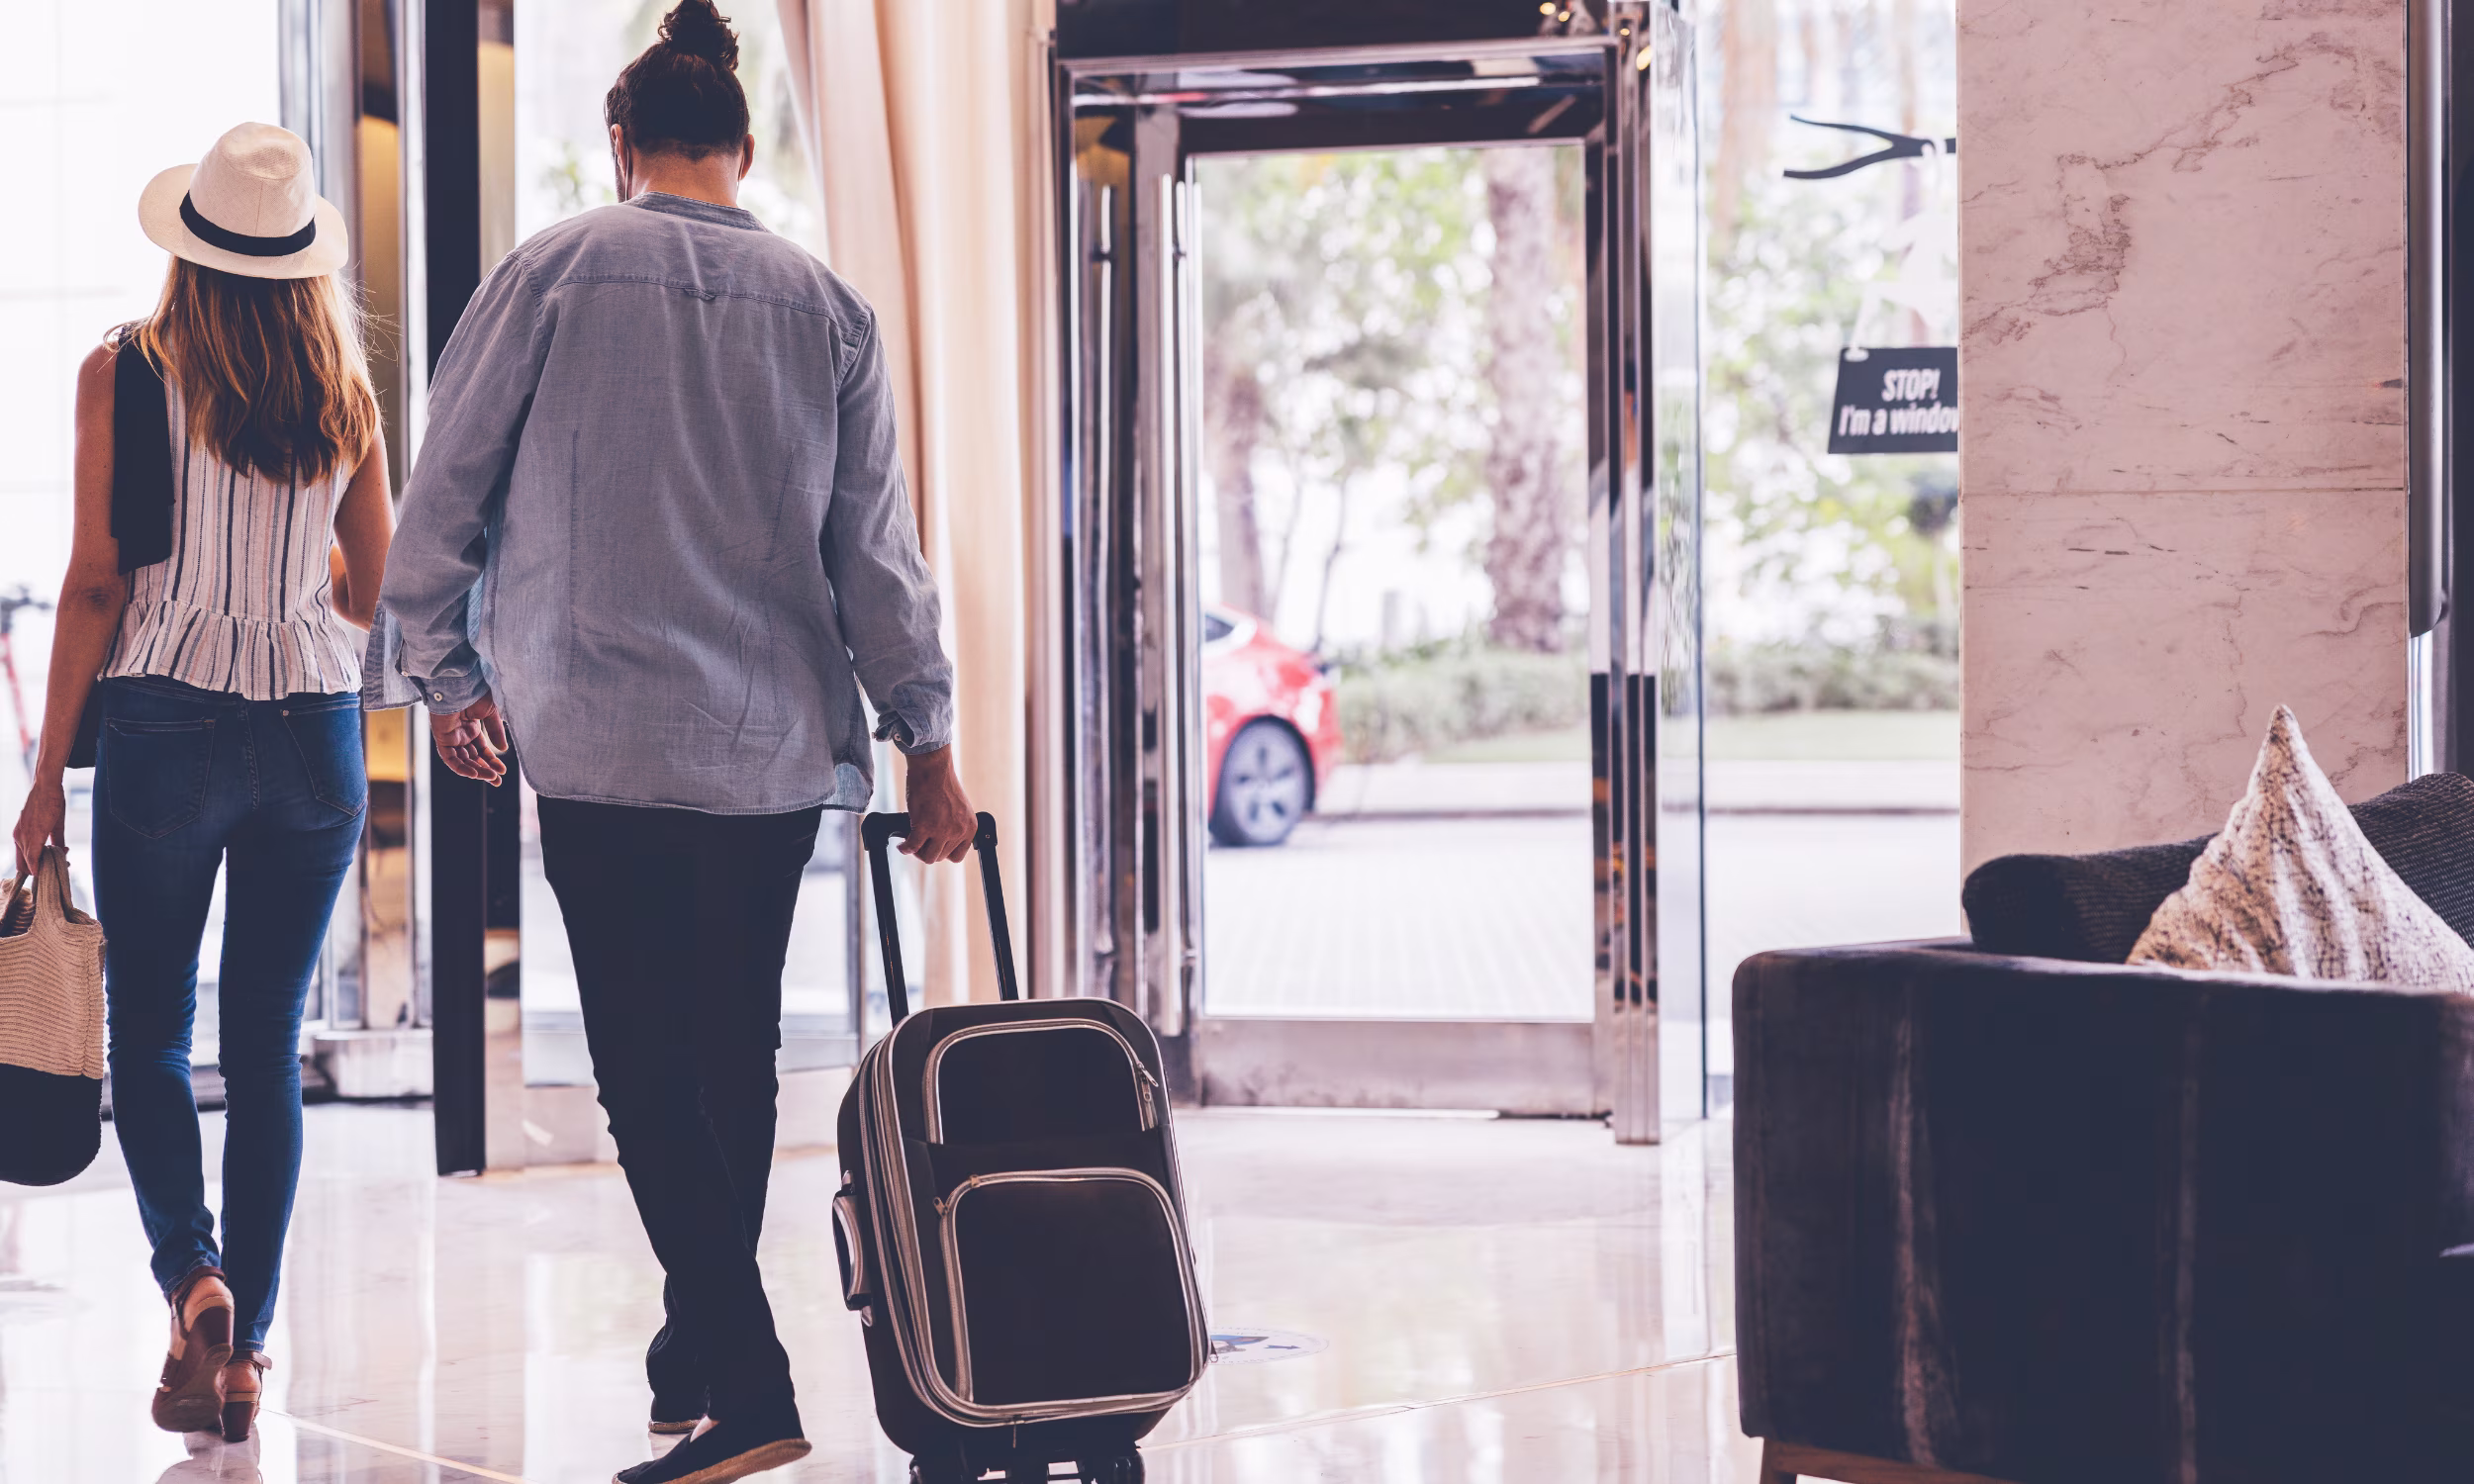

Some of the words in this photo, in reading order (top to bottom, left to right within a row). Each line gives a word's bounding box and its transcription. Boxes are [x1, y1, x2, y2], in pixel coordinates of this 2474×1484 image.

[1881, 367, 1941, 402] STOP!
[1838, 405, 1871, 436] I'm
[1871, 408, 1888, 435] a
